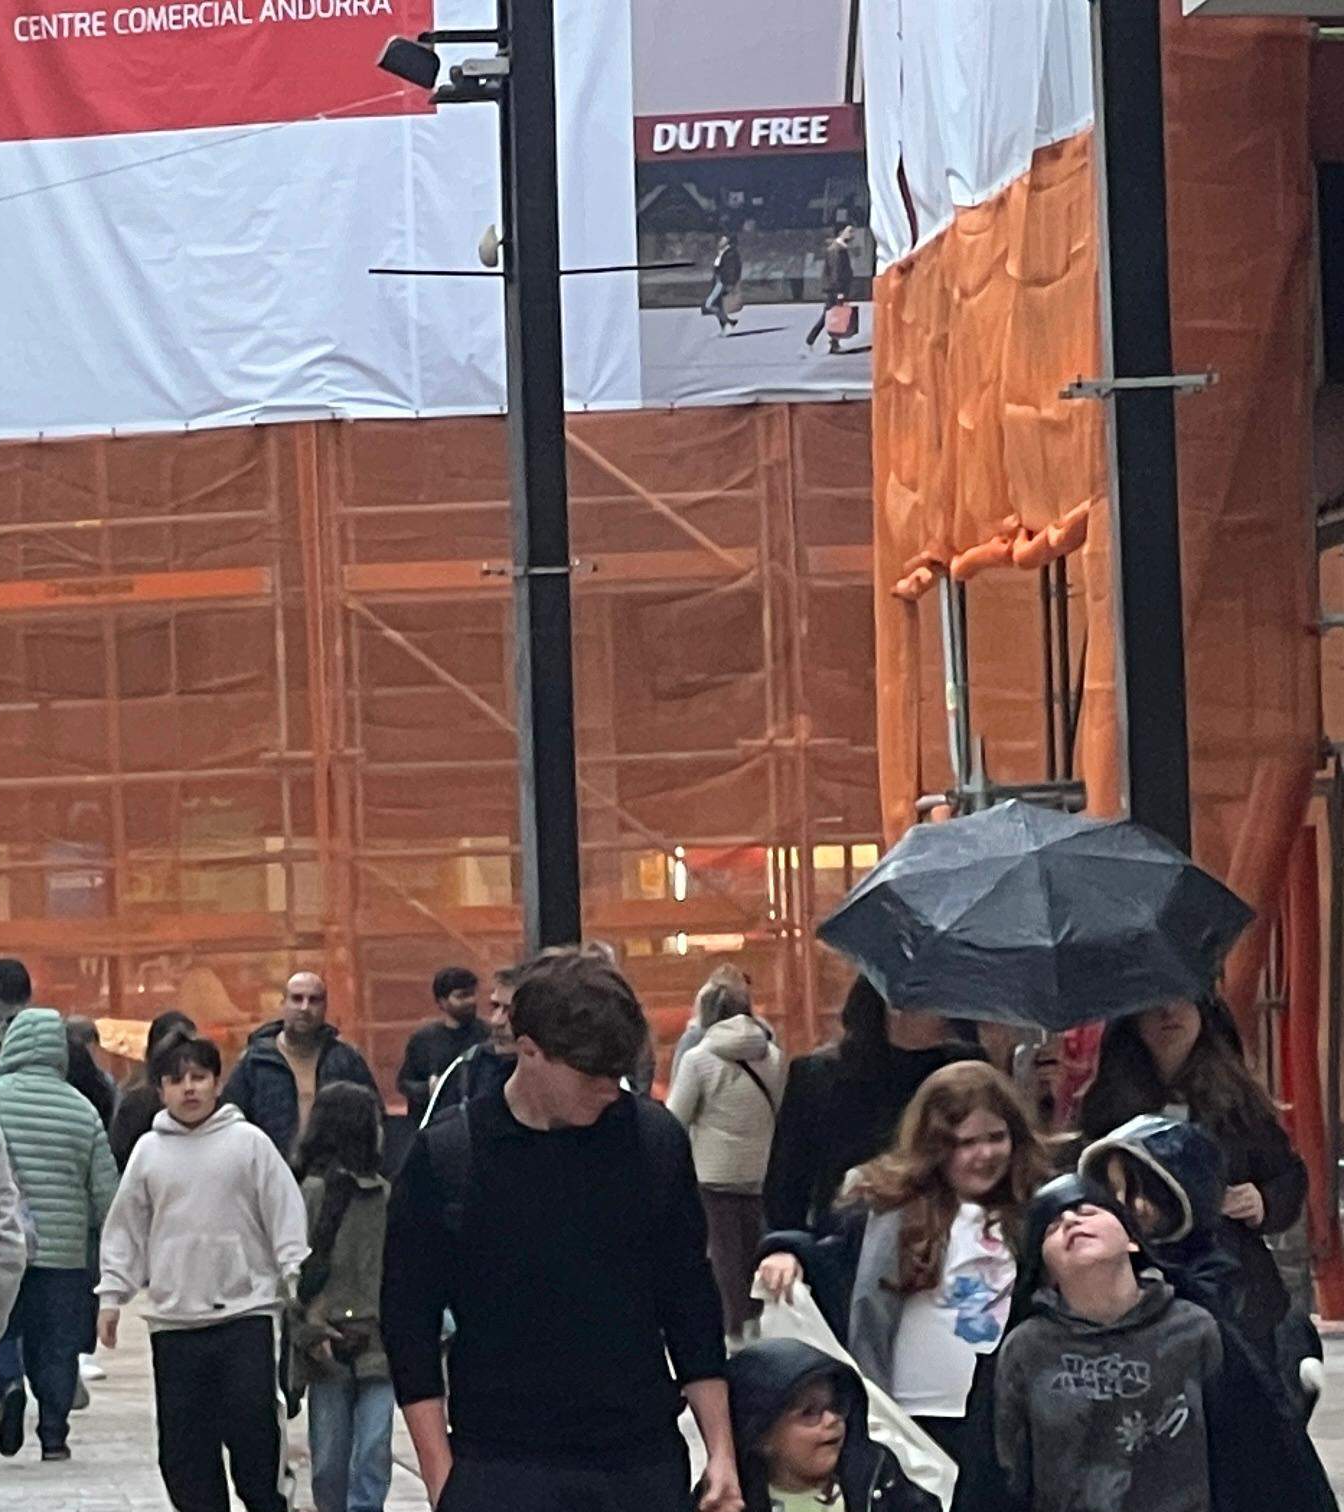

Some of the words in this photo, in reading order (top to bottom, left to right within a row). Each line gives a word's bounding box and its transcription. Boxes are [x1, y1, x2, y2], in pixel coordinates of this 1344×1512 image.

[13, 11, 107, 42] CENTRE
[112, 0, 253, 34] COMERCIAL
[652, 119, 743, 153] DUTY
[750, 115, 830, 147] FREE
